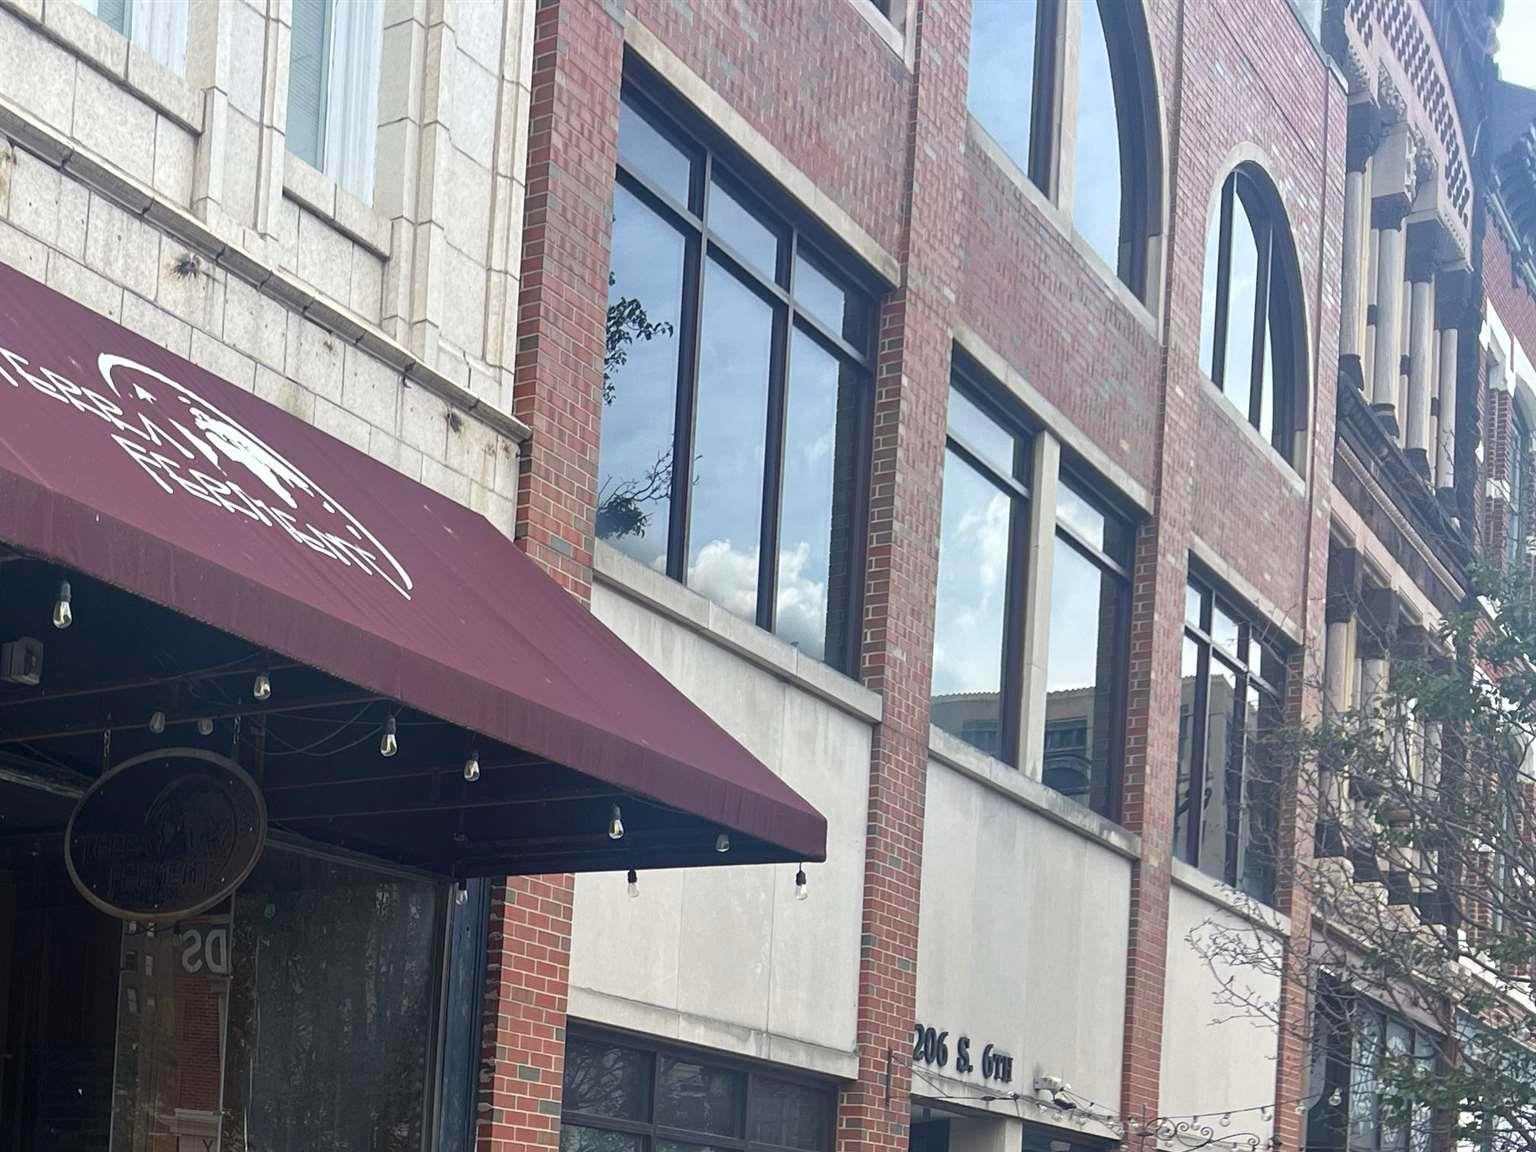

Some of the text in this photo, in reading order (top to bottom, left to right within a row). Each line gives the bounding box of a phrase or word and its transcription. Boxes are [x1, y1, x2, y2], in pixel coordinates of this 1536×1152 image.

[111, 433, 412, 601] FERMENT
[913, 1023, 1014, 1083] 206 S. 6TH
